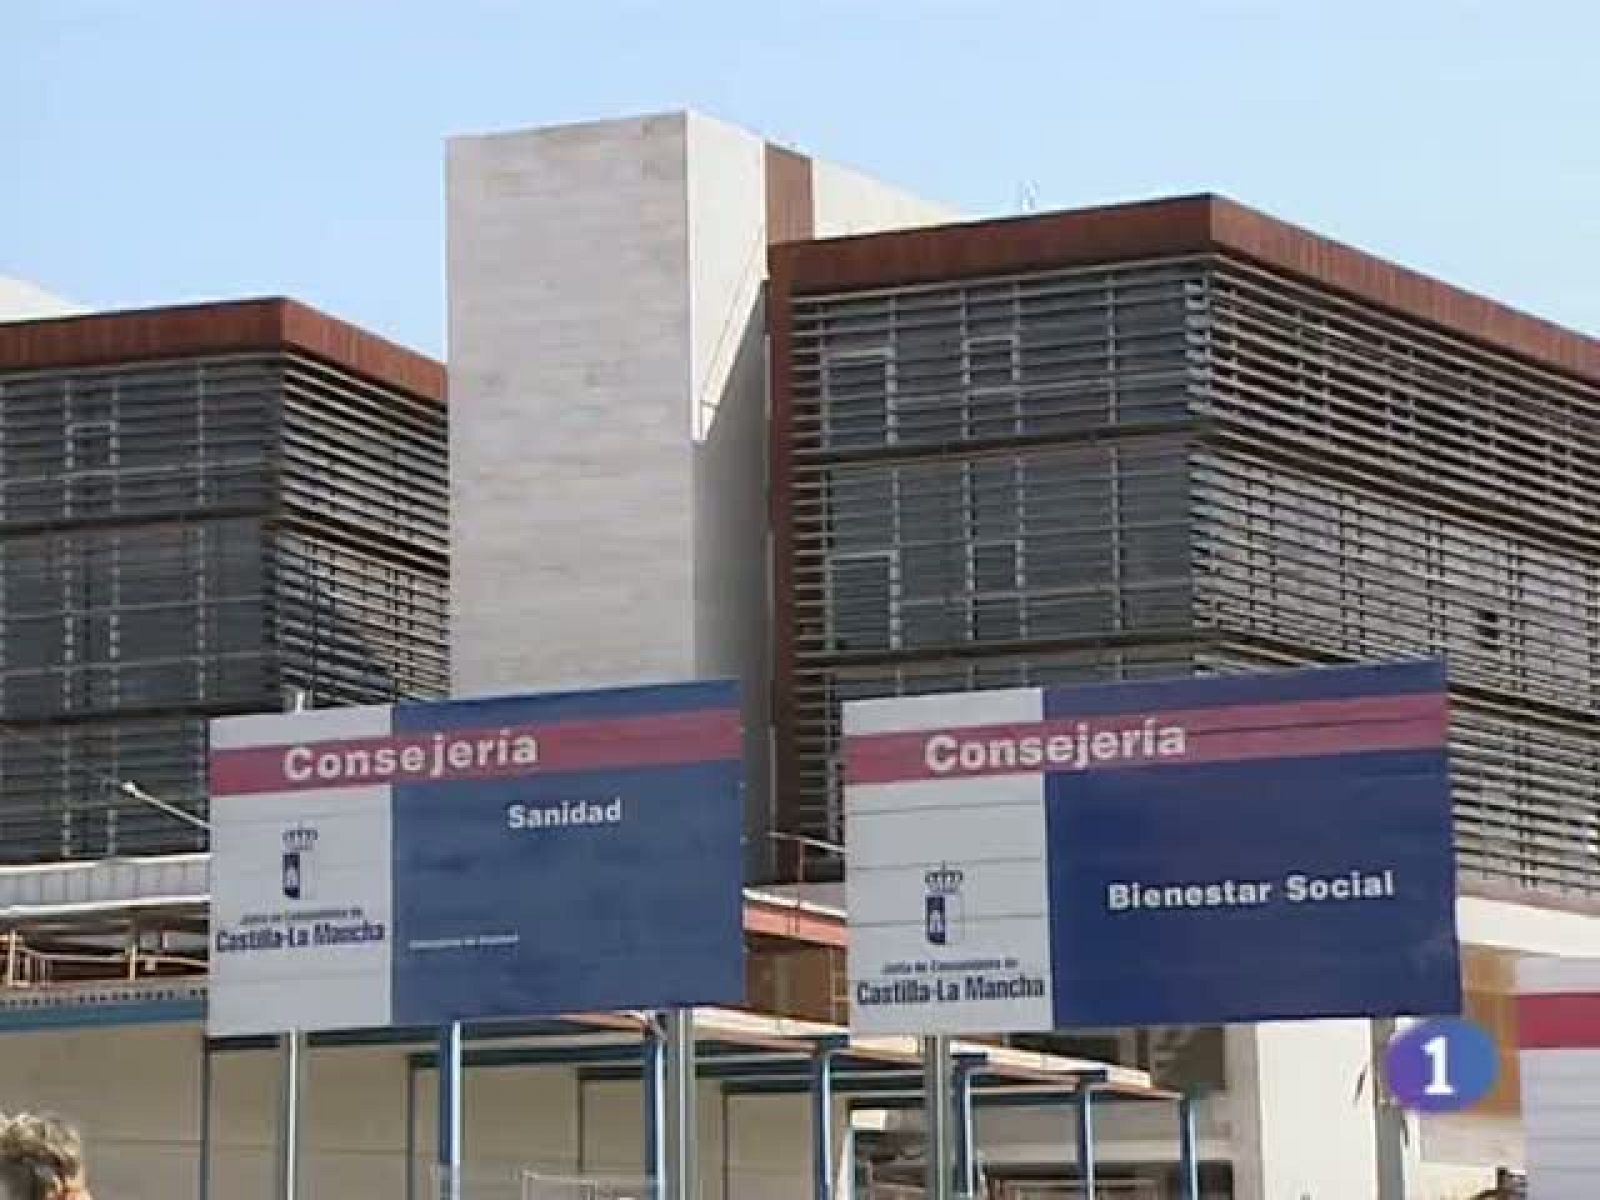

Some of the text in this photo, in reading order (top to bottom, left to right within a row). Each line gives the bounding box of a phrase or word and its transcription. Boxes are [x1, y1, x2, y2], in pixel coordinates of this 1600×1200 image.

[283, 728, 539, 782] Consejería
[924, 717, 1187, 771] Consejería
[507, 797, 622, 829] Sanidad
[1107, 869, 1394, 911] Bienestar Social
[965, 973, 1046, 1001] Mancha
